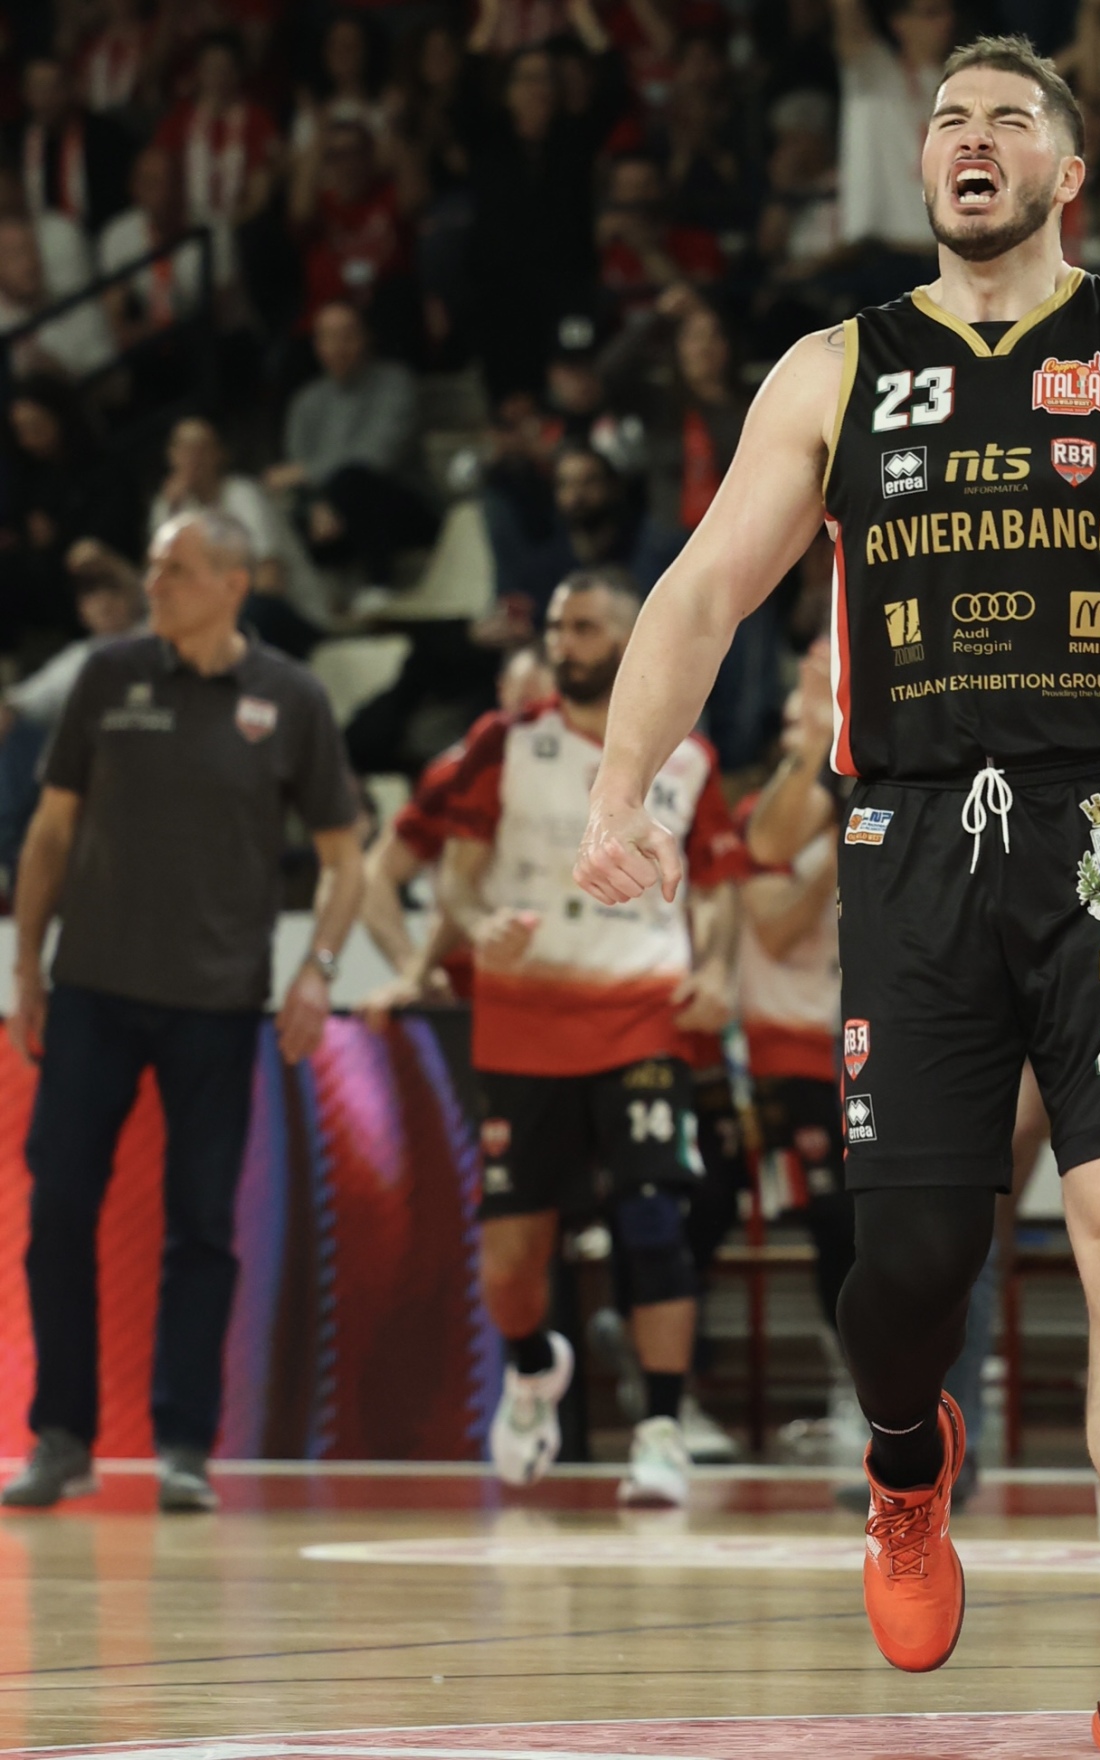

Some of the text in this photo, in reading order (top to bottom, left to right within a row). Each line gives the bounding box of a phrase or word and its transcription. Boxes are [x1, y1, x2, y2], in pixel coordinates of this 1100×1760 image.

[1036, 373, 1100, 407] ITALIA
[872, 366, 956, 433] 23
[945, 443, 1032, 482] nts
[885, 476, 924, 494] errea
[964, 484, 1028, 494] INFORMATICA
[953, 627, 990, 639] Audi
[953, 640, 1012, 655] Reggini
[890, 677, 947, 702] ITALIAN
[949, 673, 1055, 691] EXHIBITION
[1042, 689, 1077, 698] Providing
[849, 1124, 873, 1140] errea
